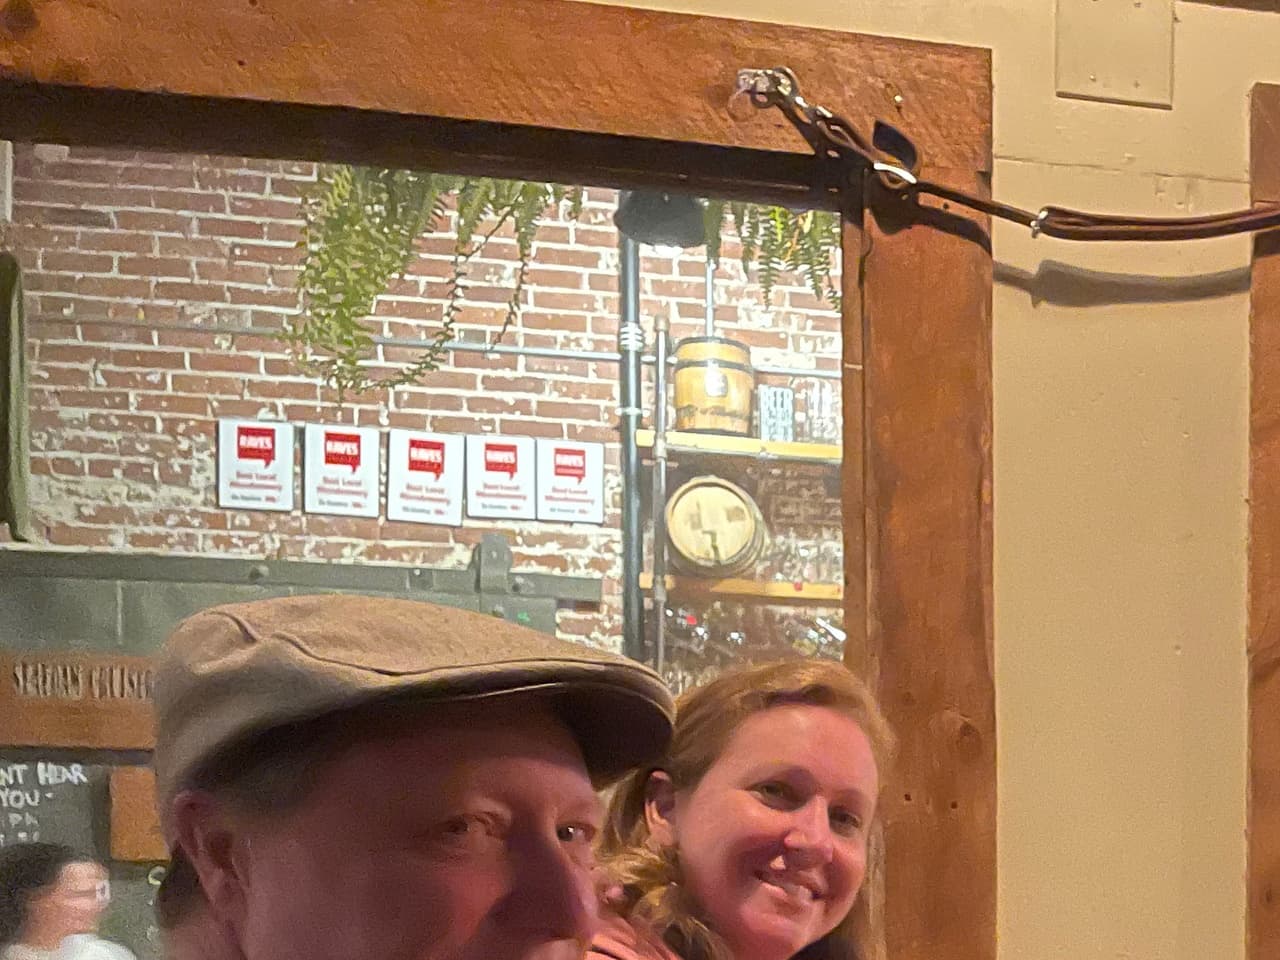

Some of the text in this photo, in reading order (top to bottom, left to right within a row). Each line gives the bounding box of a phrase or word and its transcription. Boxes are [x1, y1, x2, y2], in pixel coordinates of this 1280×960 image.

[239, 435, 272, 449] RAVES
[326, 441, 358, 455] RAVES
[410, 447, 442, 462] RAVES
[486, 450, 516, 463] RAVES
[37, 761, 88, 785] HEAR
[0, 786, 40, 808] YOU
